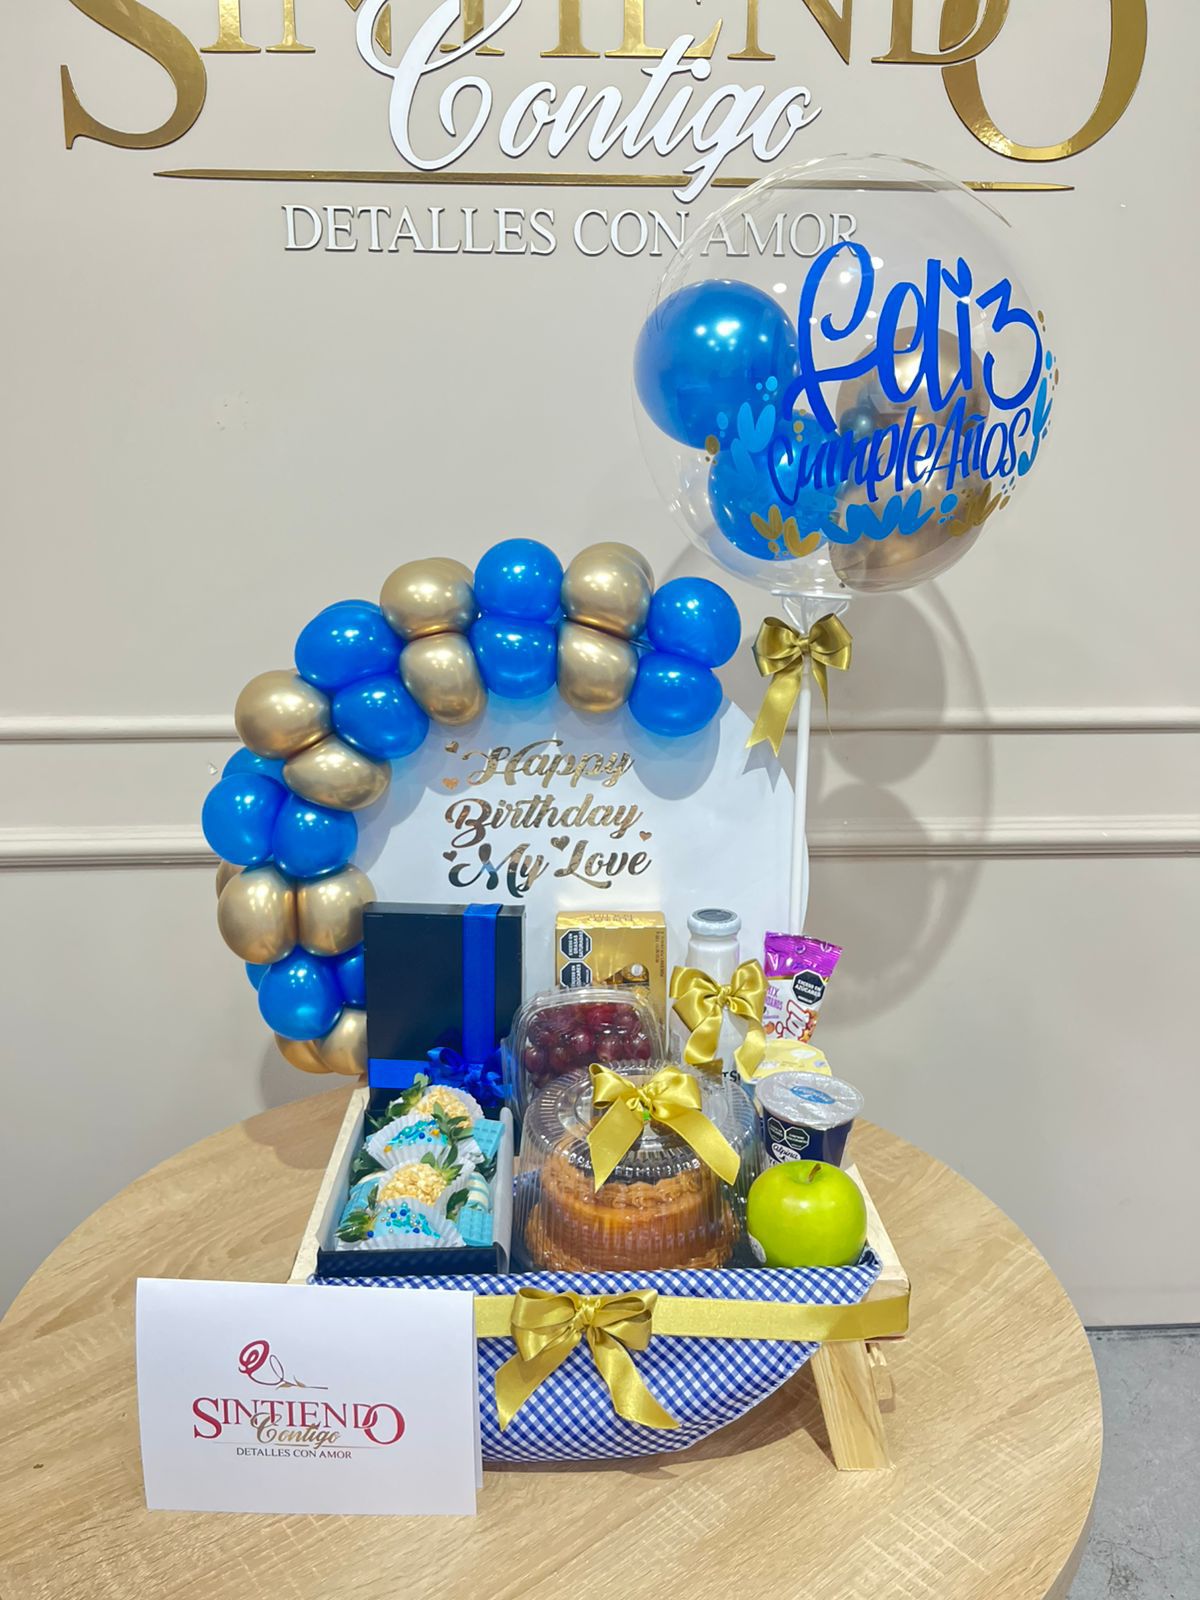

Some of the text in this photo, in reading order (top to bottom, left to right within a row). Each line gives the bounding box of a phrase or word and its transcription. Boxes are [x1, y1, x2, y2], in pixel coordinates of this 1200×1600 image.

[355, 0, 822, 203] Contigo
[281, 204, 859, 257] DETALLES CON AMOR
[462, 739, 635, 788] Happy
[444, 793, 644, 849] Birthday
[448, 840, 652, 898] My Love
[192, 1397, 405, 1445] SINTIENDO
[250, 1411, 341, 1449] Contigo
[236, 1447, 353, 1460] DETALLES CON AMOR
